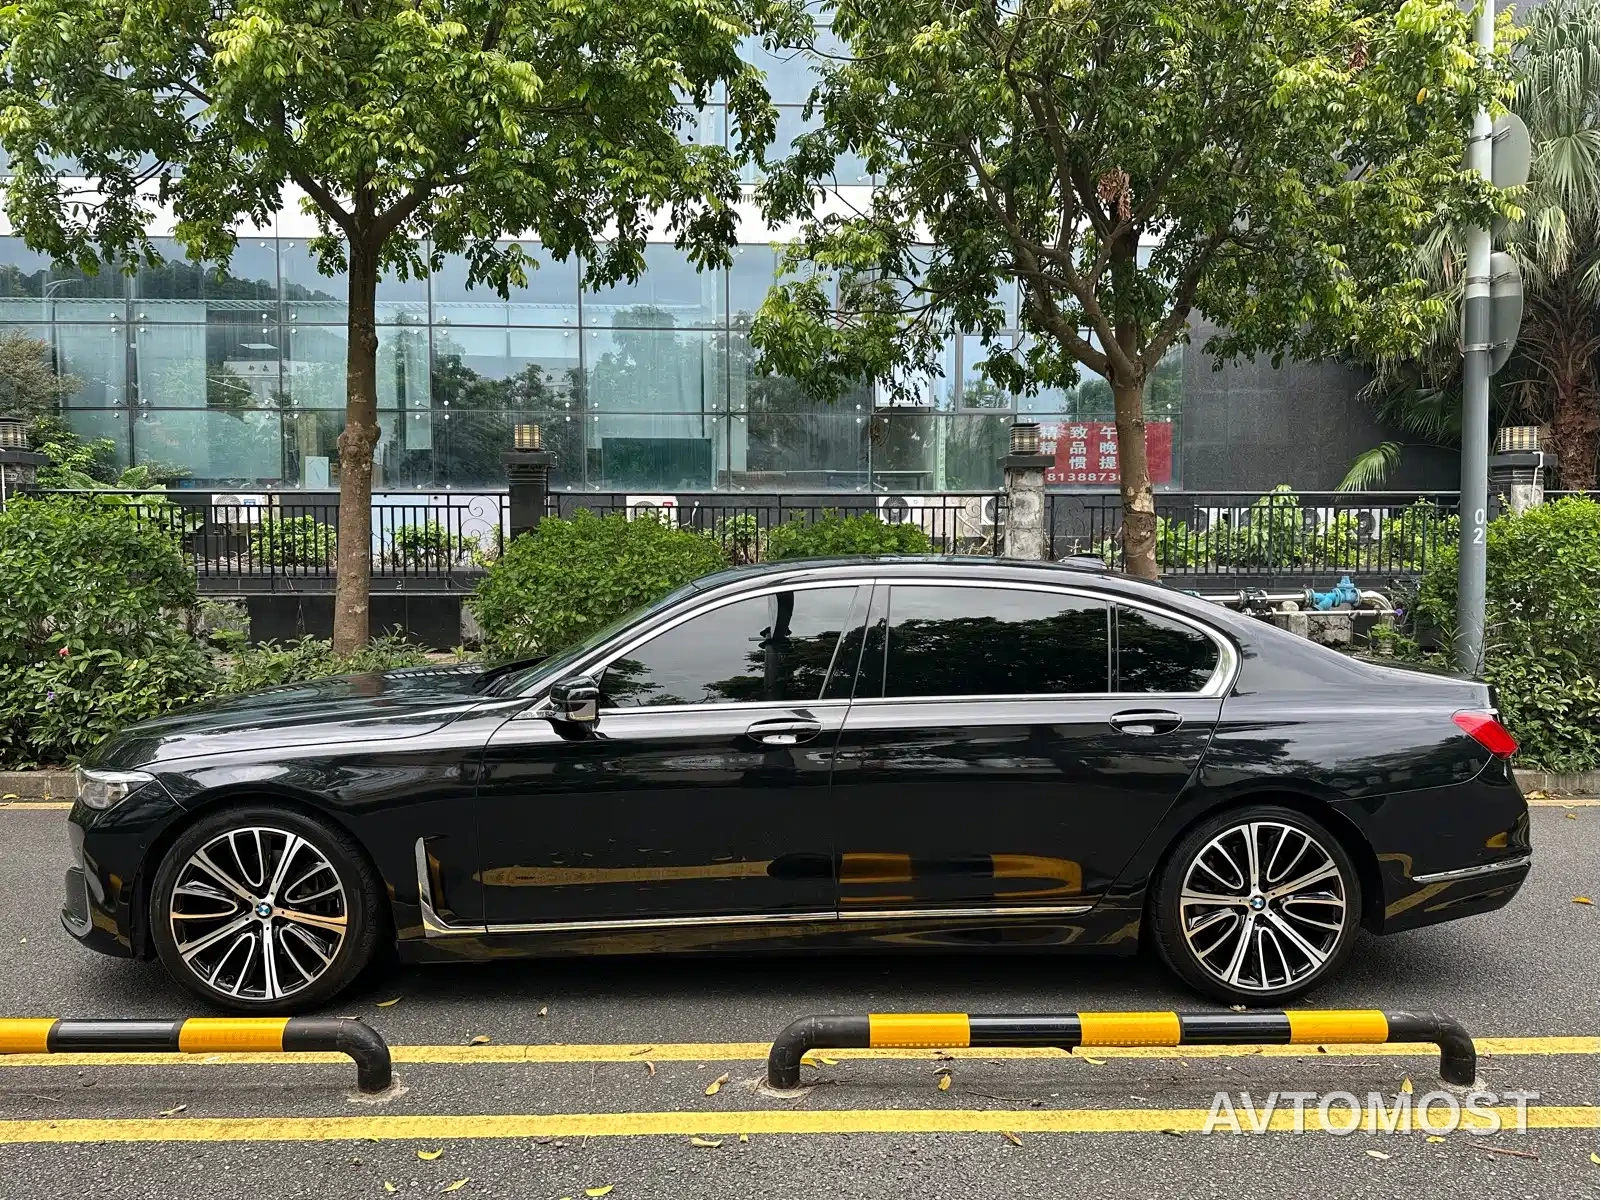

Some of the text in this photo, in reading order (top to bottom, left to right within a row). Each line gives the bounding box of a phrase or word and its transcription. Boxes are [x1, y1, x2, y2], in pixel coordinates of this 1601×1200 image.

[1040, 426, 1148, 439] 精致午
[1040, 441, 1148, 455] 精品晚
[1047, 472, 1120, 481] 8138873
